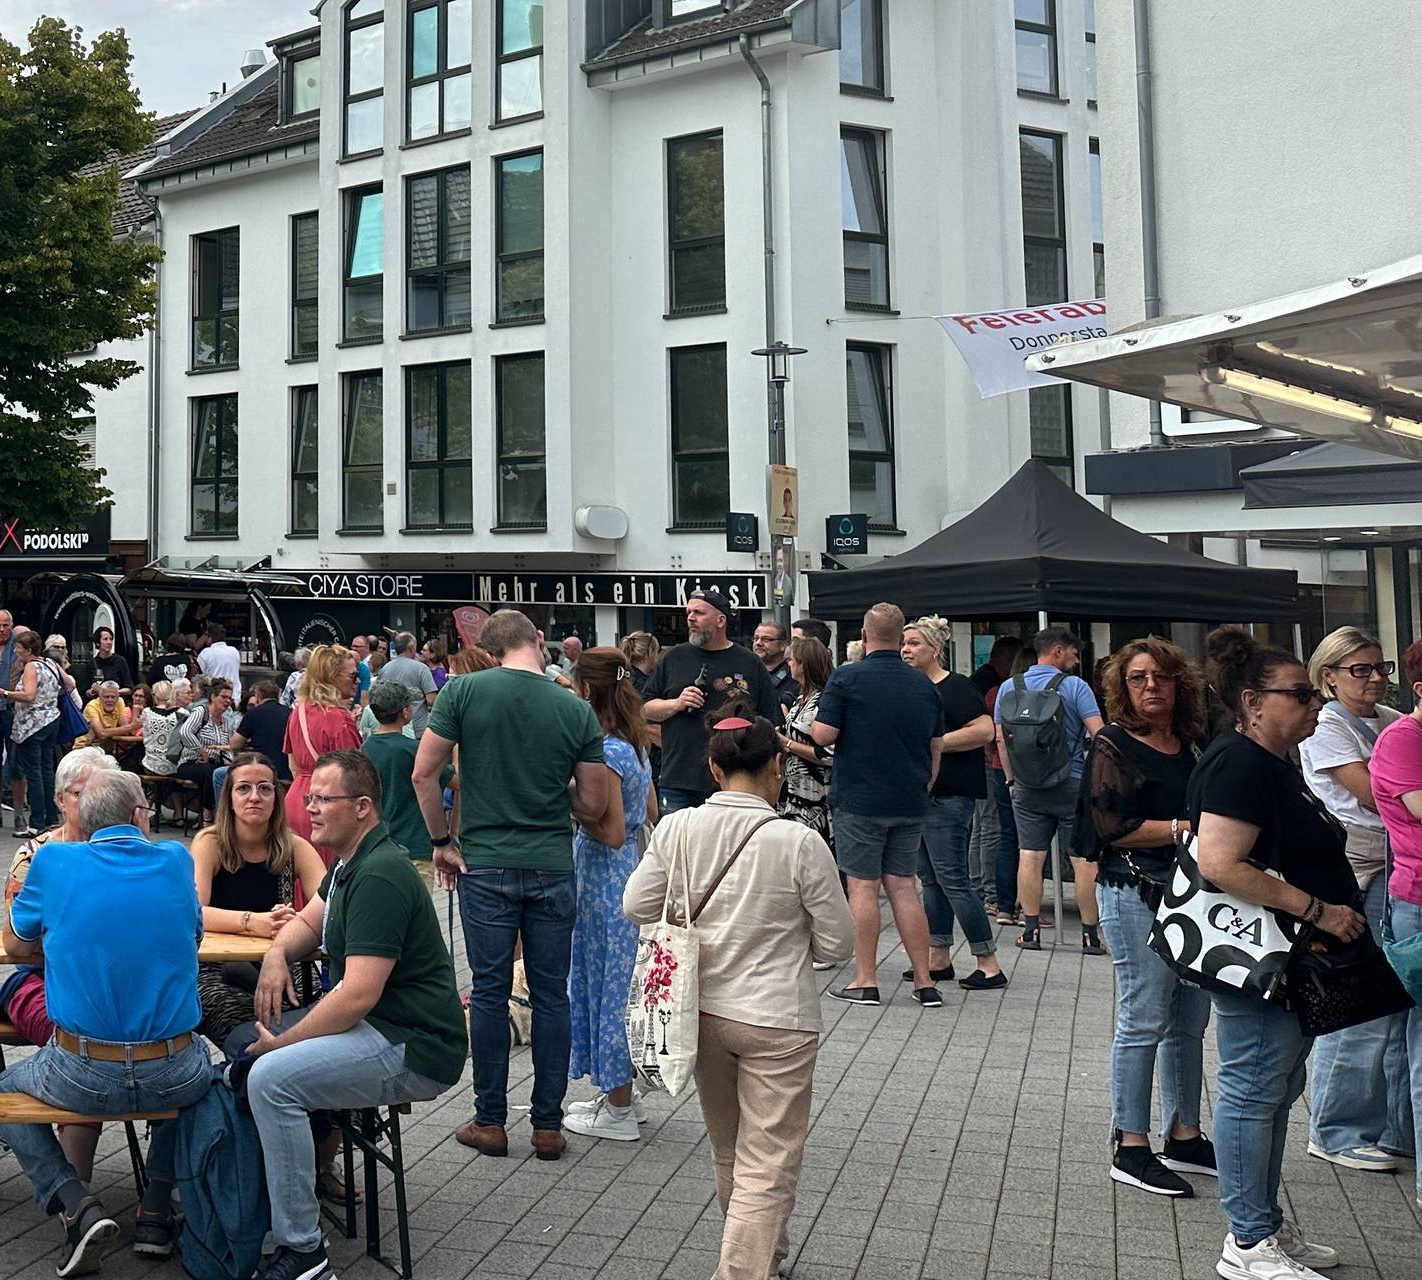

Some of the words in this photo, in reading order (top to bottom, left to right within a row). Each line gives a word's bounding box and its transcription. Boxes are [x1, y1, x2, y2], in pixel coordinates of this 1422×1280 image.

[734, 536, 754, 546] IQOS
[833, 537, 860, 546] IQOS
[308, 574, 353, 598] ÇIYA
[356, 575, 424, 597] STORE
[479, 576, 538, 602] Mehr
[555, 576, 595, 603] als
[613, 576, 655, 604] ein
[1207, 902, 1264, 948] C&A
